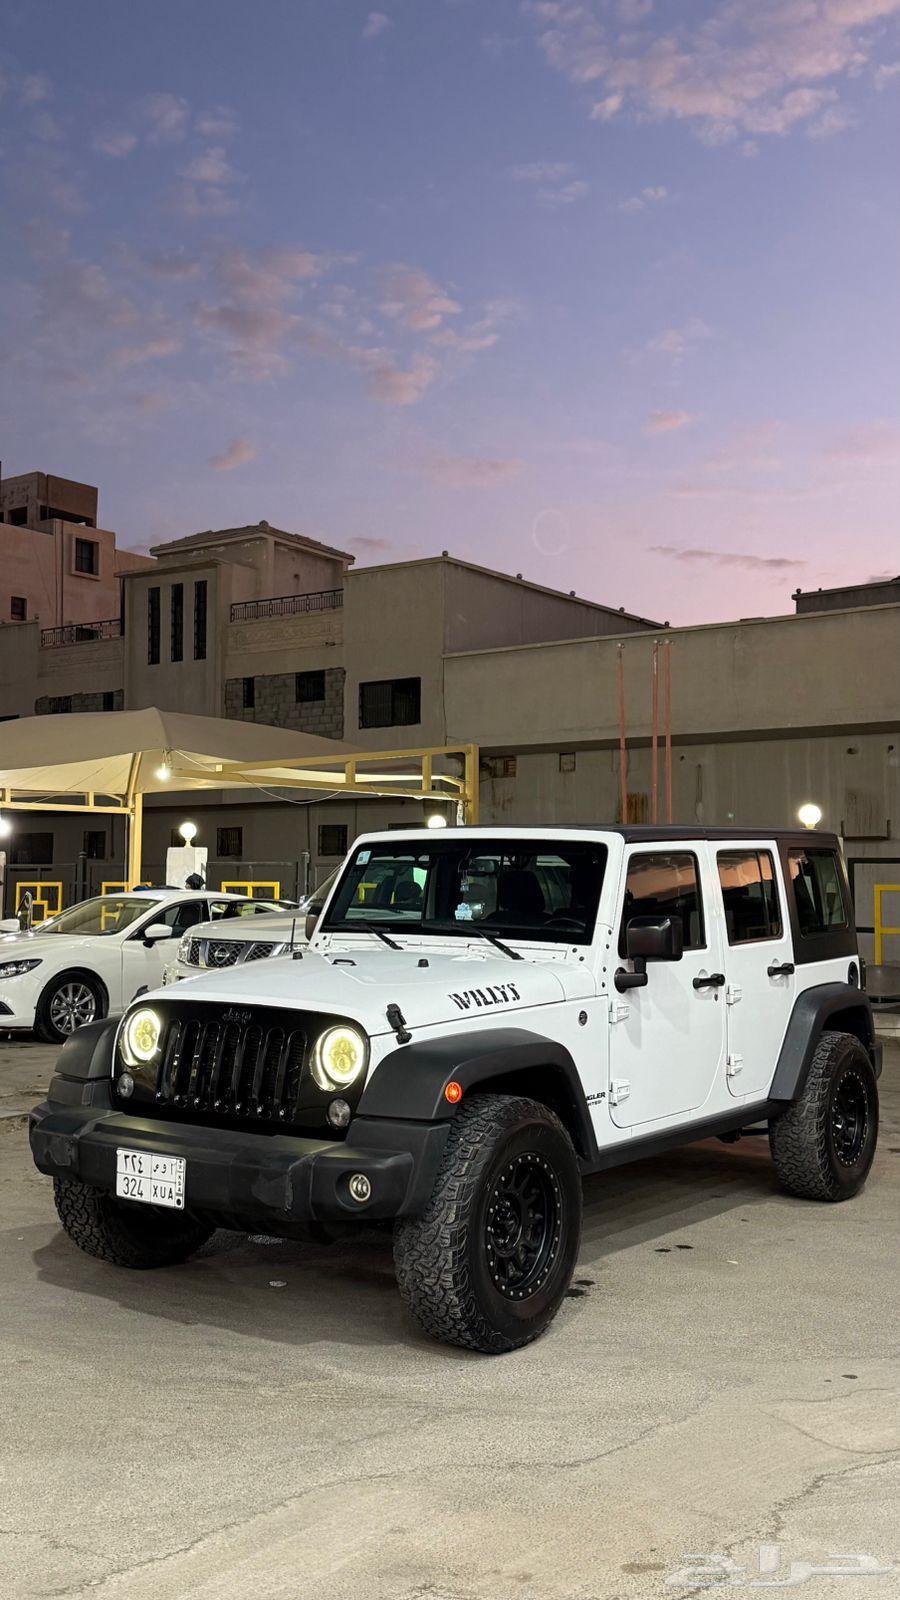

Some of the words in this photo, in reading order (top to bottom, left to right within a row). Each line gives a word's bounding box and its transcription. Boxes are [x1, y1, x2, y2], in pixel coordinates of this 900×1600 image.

[447, 982, 520, 1010] WILLYS
[123, 1176, 144, 1198] 324
[152, 1184, 174, 1200] XUA
